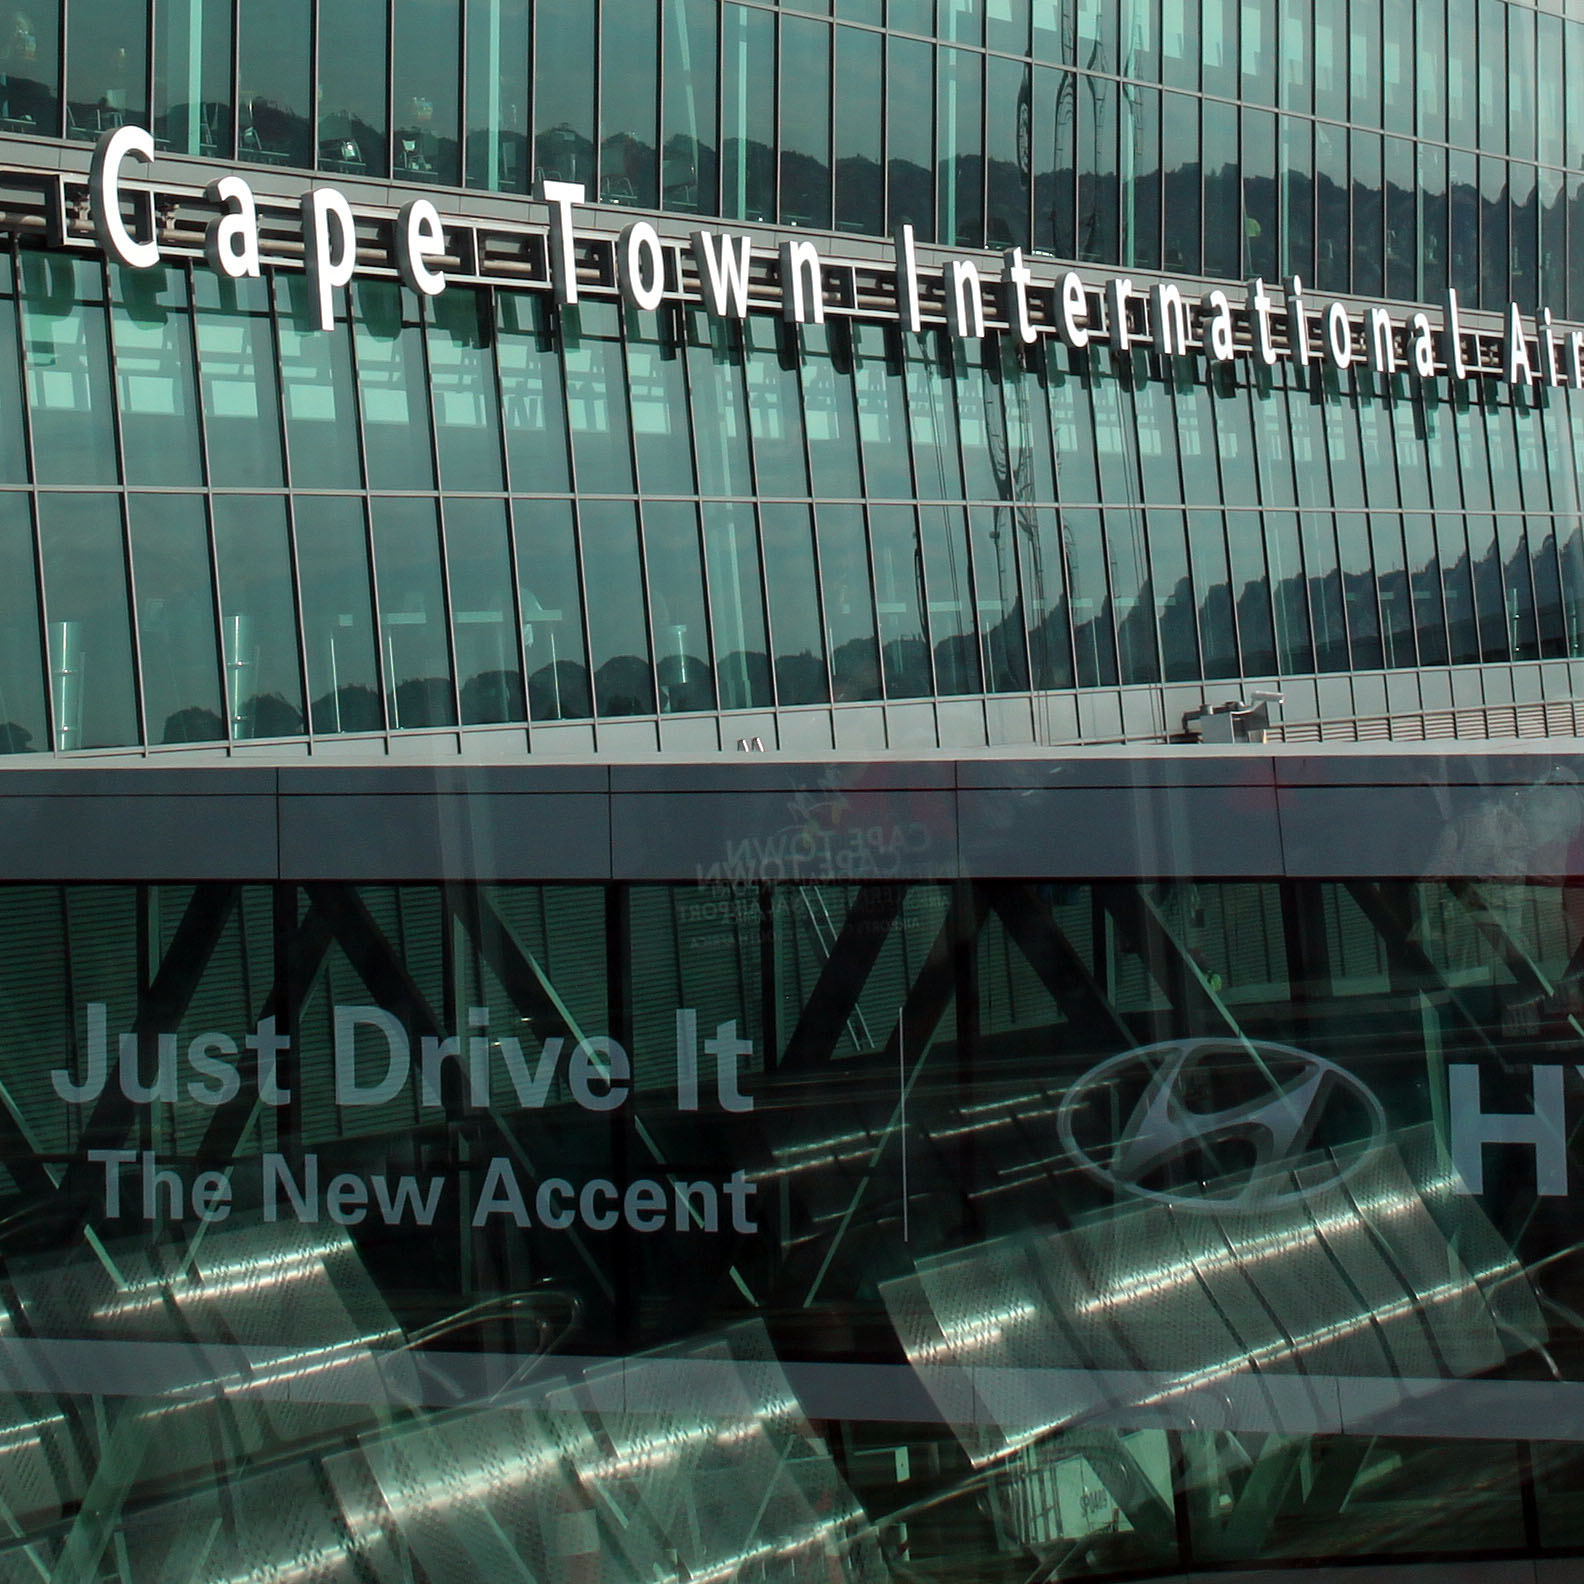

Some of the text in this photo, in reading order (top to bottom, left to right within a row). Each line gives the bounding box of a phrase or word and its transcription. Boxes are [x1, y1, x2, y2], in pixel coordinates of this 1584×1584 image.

[91, 125, 446, 331] Cape
[533, 180, 824, 325] Town
[895, 224, 1467, 380] International
[50, 1002, 755, 1114] Just Drive It
[87, 1149, 759, 1234] The New Accent
